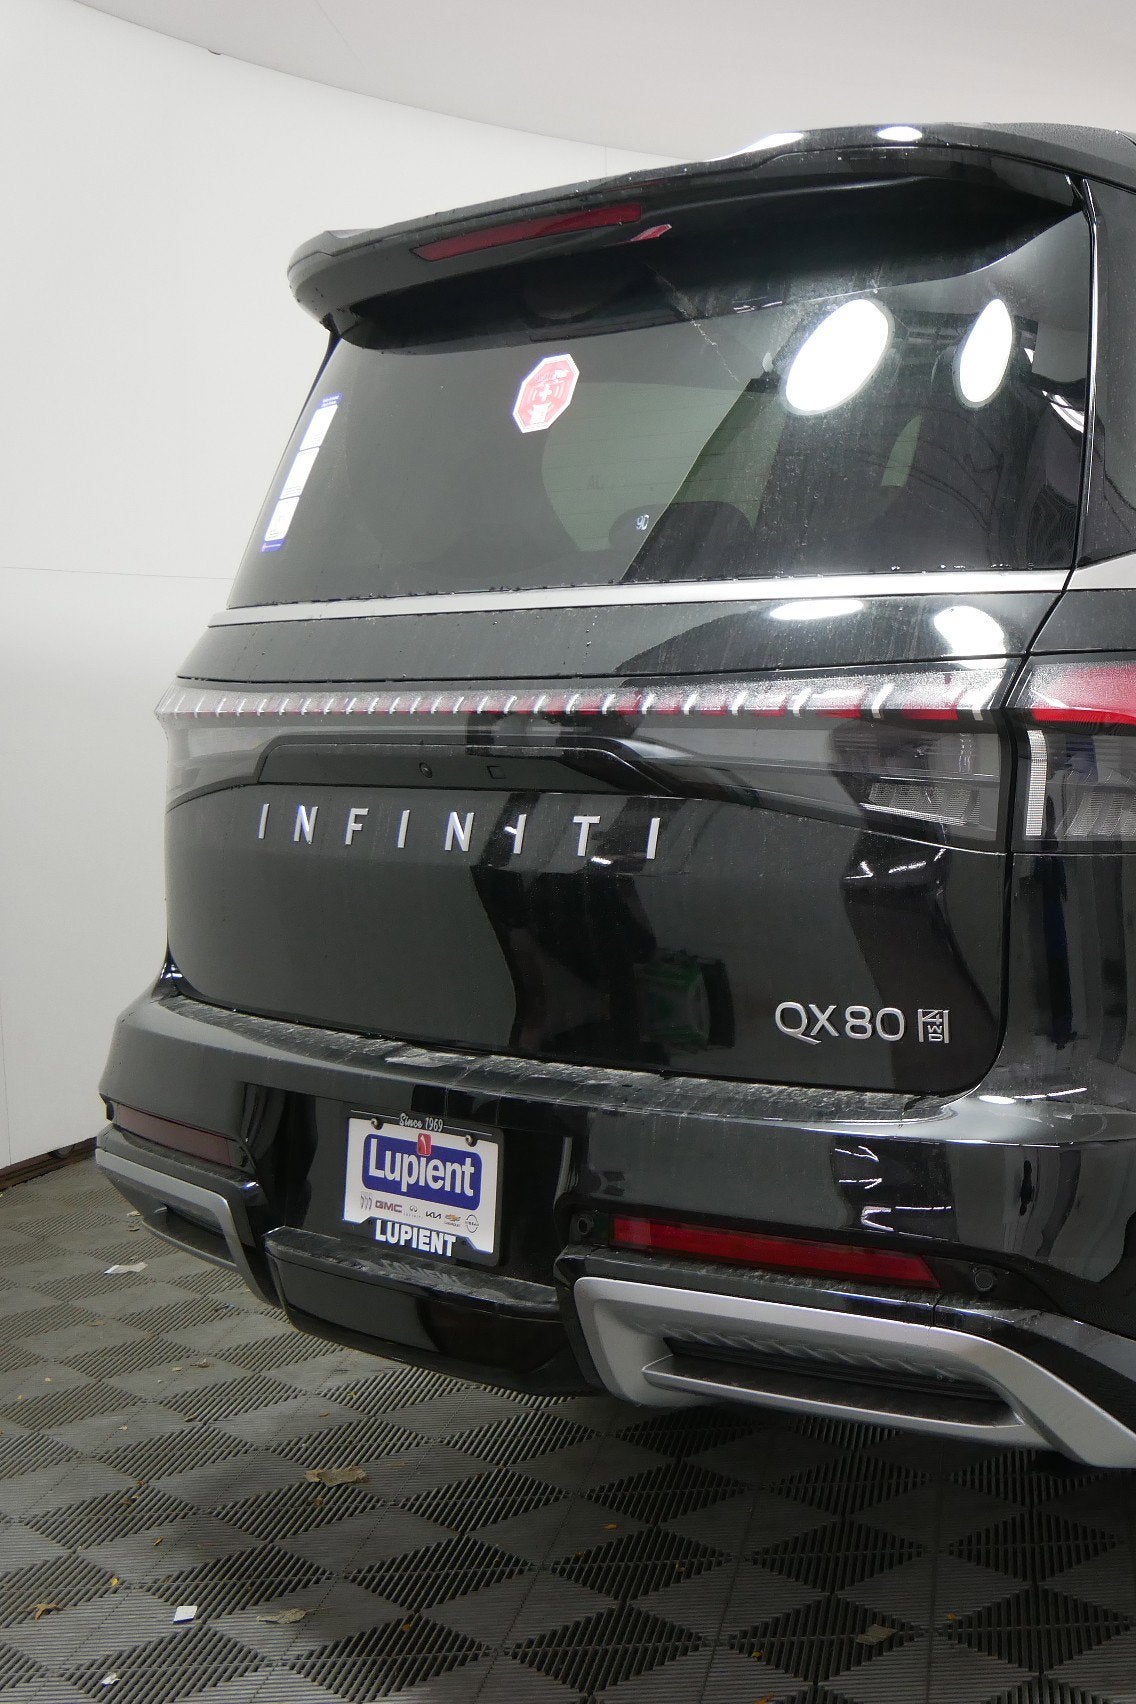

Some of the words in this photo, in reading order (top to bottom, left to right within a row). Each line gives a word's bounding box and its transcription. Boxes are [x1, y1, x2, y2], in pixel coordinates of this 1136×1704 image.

[258, 803, 661, 860] INFINITI
[775, 1001, 906, 1046] QX80
[399, 1113, 423, 1129] Since
[425, 1117, 444, 1132] 1969
[369, 1138, 475, 1197] Lupient
[374, 1200, 403, 1213] GMC
[375, 1219, 456, 1257] LUPIENT
